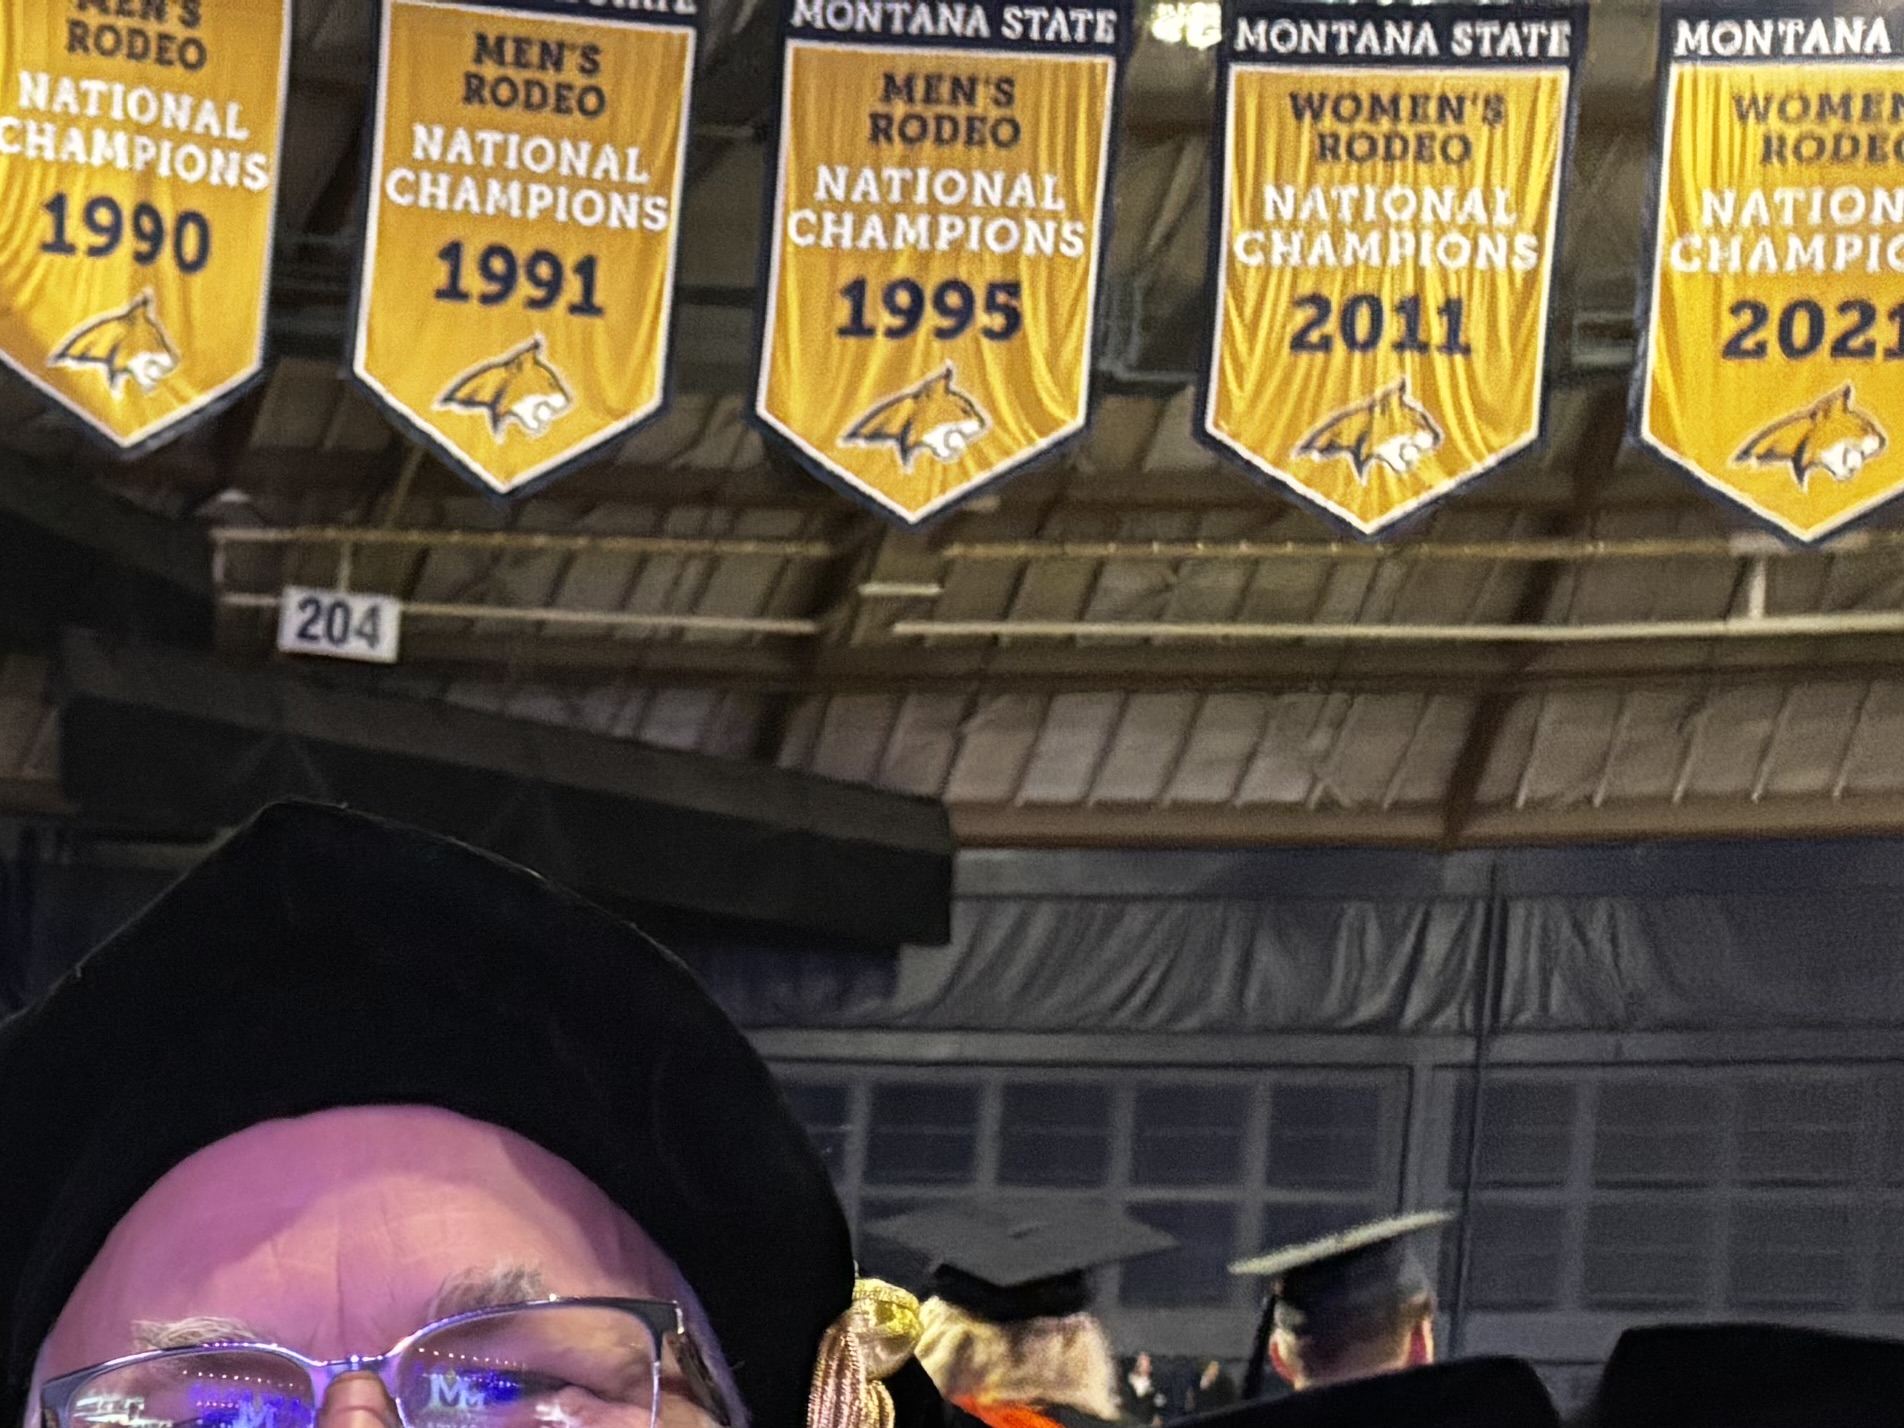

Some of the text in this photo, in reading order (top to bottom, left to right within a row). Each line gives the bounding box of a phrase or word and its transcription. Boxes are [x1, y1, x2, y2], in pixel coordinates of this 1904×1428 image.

[65, 18, 208, 73] RODEO
[790, 0, 1118, 43] MONTANA STATE
[1233, 17, 1572, 57] MONTANA STATE
[1673, 16, 1892, 56] MONTANA
[472, 31, 603, 77] MEN'S
[18, 70, 250, 141] NATIONAL
[463, 70, 606, 121] RODEO
[880, 72, 1016, 108] MEN'S
[1289, 90, 1507, 127] WOMEN'S
[412, 122, 651, 184] NATIONAL
[868, 113, 1022, 148] RODEO
[1317, 131, 1473, 164] RODEO
[385, 167, 669, 232] CHAMPIONS
[814, 164, 1066, 212] NATIONAL
[1263, 182, 1517, 227] NATIONAL
[39, 191, 213, 275] 1990
[787, 208, 1086, 258] CHAMPIONS
[1233, 228, 1539, 271] CHAMPIONS
[434, 239, 604, 317] 1991
[836, 276, 1023, 342] 1995
[1289, 292, 1472, 356] 2011
[296, 596, 381, 650] 204
